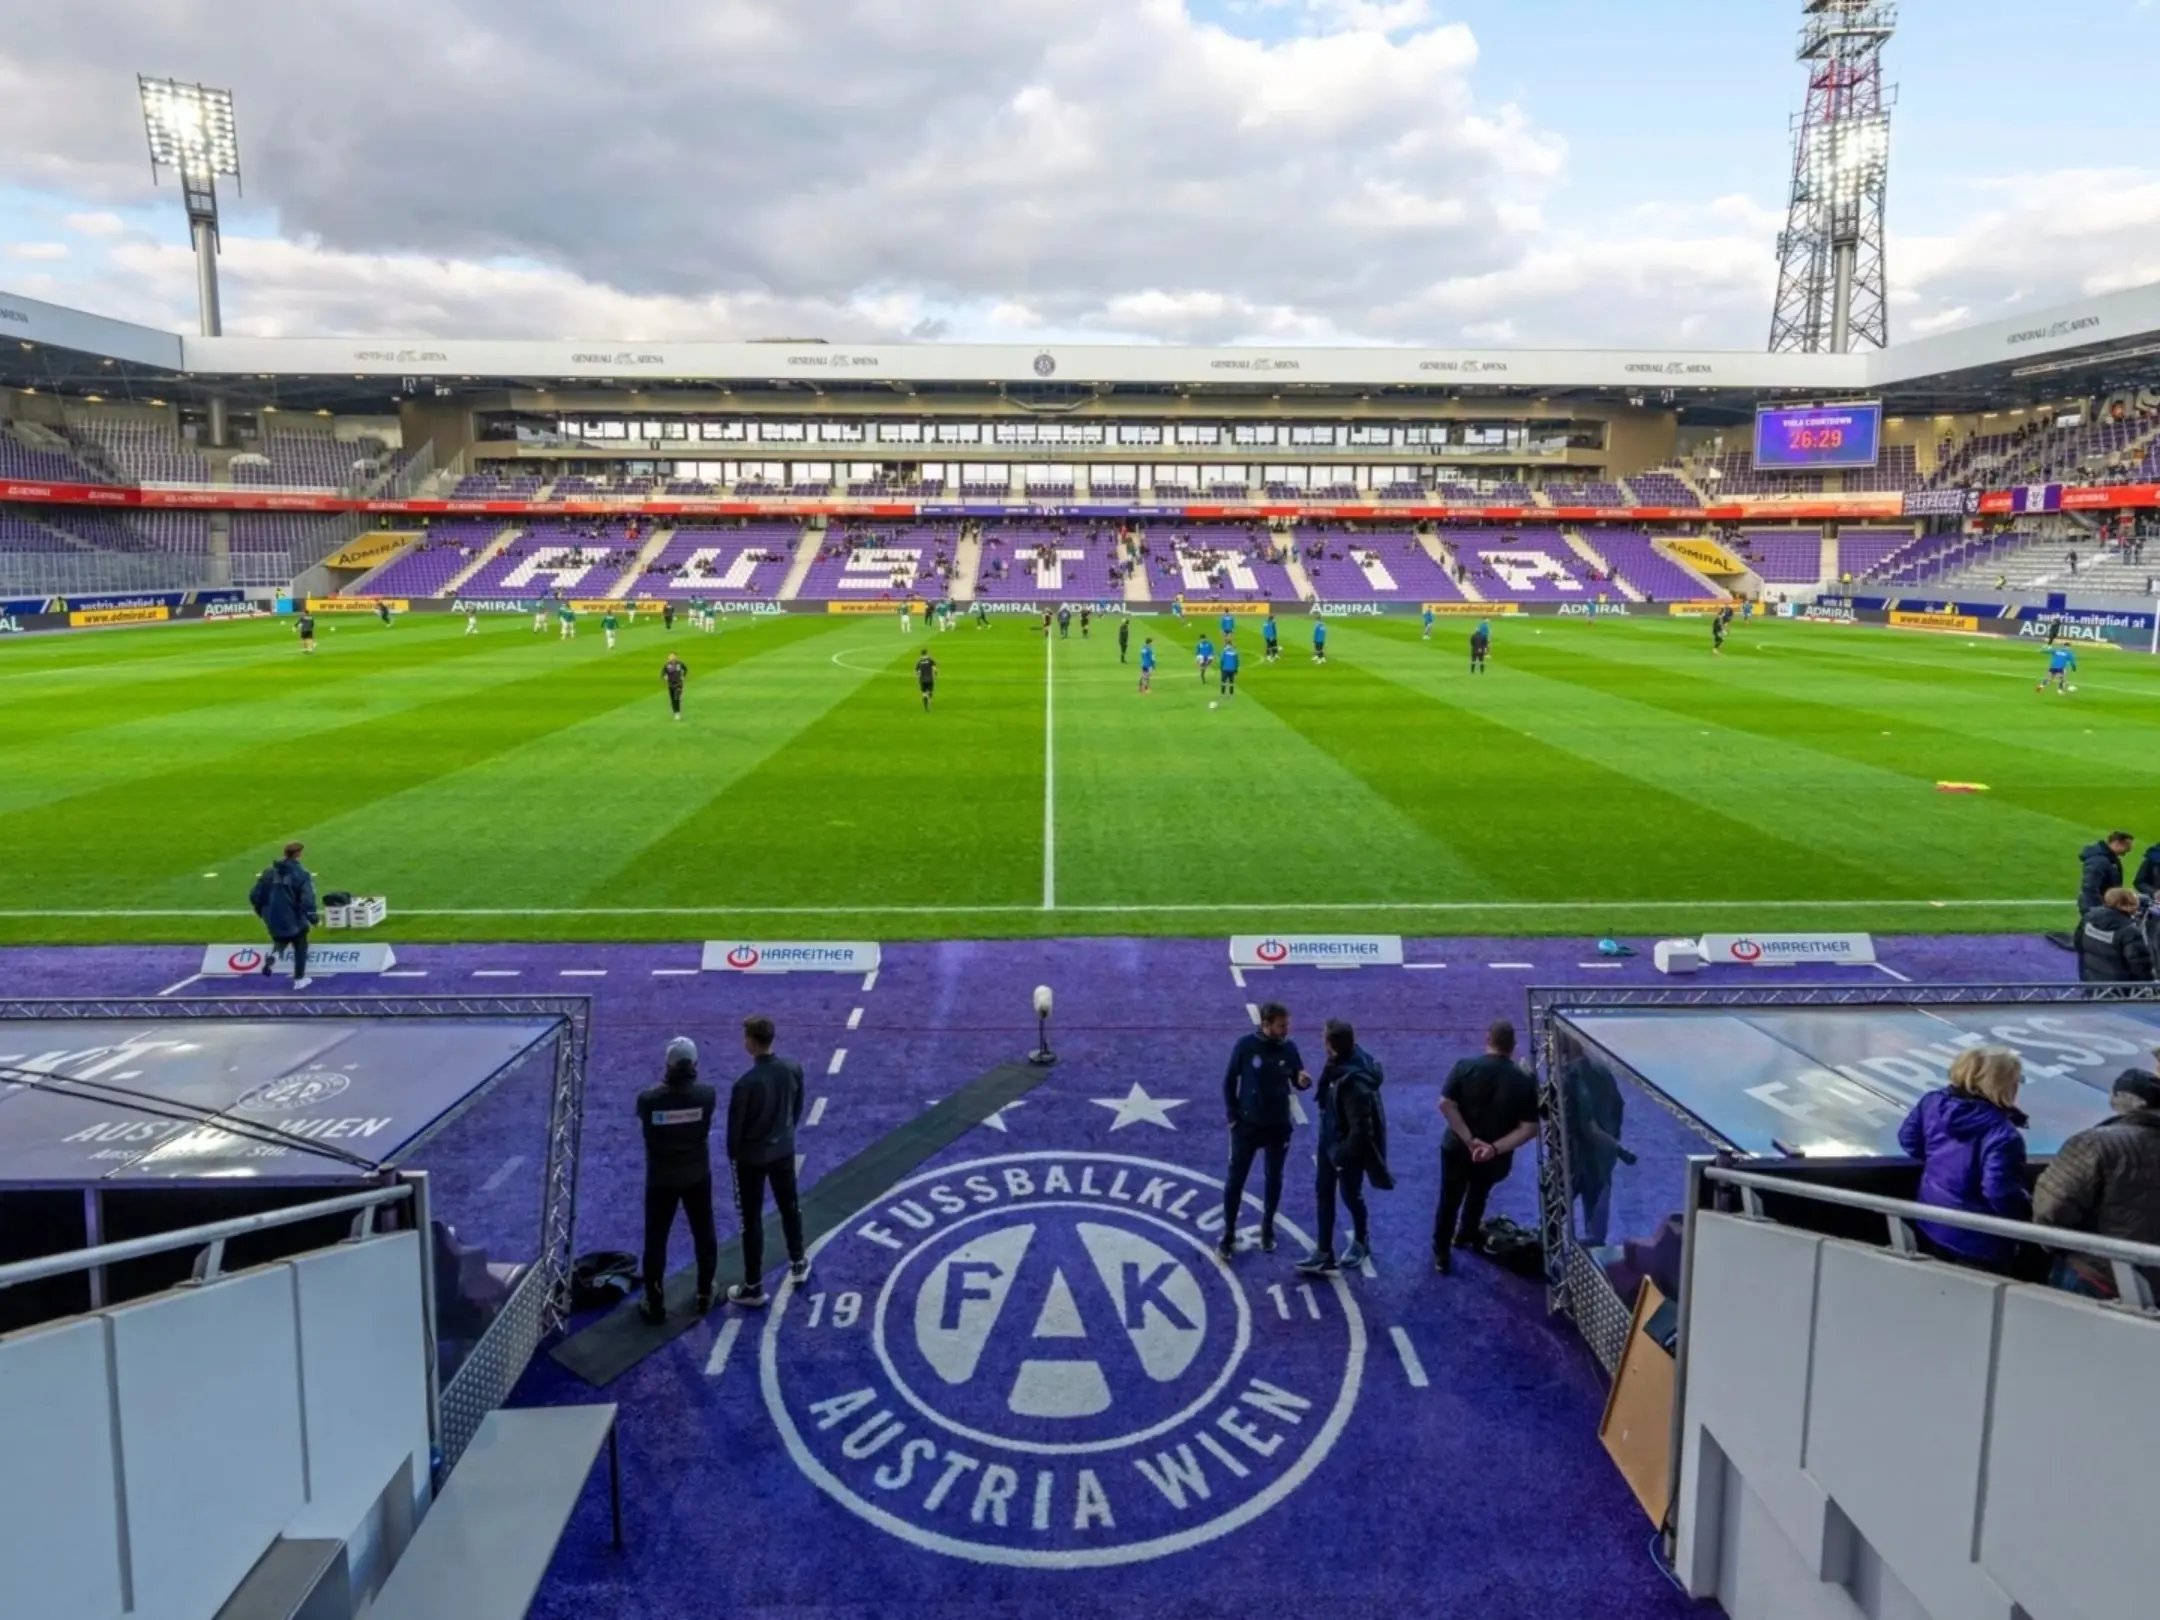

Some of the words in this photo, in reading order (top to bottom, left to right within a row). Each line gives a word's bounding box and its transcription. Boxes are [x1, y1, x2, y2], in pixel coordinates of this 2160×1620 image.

[2070, 316, 2100, 331] ARENA
[1789, 430, 1842, 449] 26:29
[338, 536, 410, 565] ADMIRAL
[1667, 541, 1733, 572] ADMIRAL
[204, 600, 262, 616] ADMIRAL
[452, 599, 529, 613] ADMIRAL
[714, 600, 788, 613] ADMIRAL
[968, 601, 1043, 614] ADMIRAL
[1309, 602, 1384, 615] ADMIRAL
[1804, 605, 1857, 620] ADMIRAL
[84, 611, 157, 624] www.admiral.at
[2019, 620, 2108, 642] ADIRAL
[1288, 943, 1379, 955] HARREITHER
[1762, 940, 1851, 953] HARREITHER
[265, 950, 360, 963] AREITHER
[761, 949, 854, 961] HARREITHER
[271, 1117, 393, 1140] WIEN
[857, 1165, 1264, 1252] FUSSBALLKLUB
[1266, 1284, 1322, 1320] 11
[807, 1291, 863, 1329] 19
[809, 1387, 1116, 1531] AUSTRIA
[1133, 1378, 1313, 1511] WIEN
